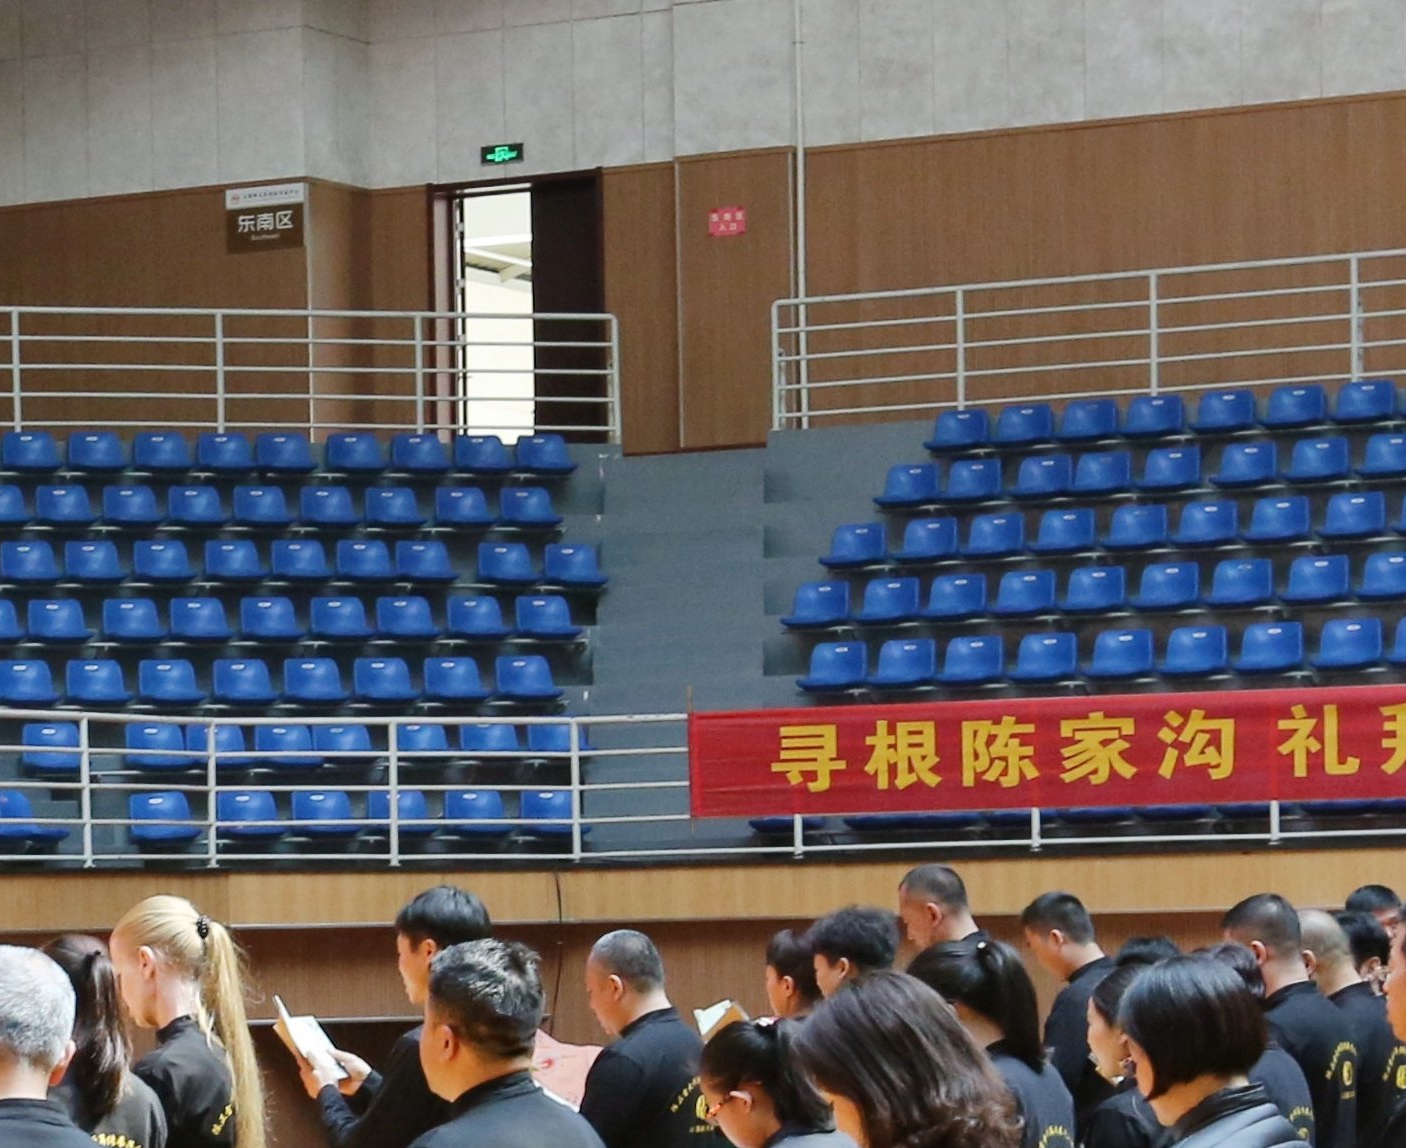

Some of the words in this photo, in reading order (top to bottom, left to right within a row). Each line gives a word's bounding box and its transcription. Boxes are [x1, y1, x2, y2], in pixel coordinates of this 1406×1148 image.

[238, 210, 293, 233] 东南区
[771, 709, 1236, 794] 寻根陈家沟
